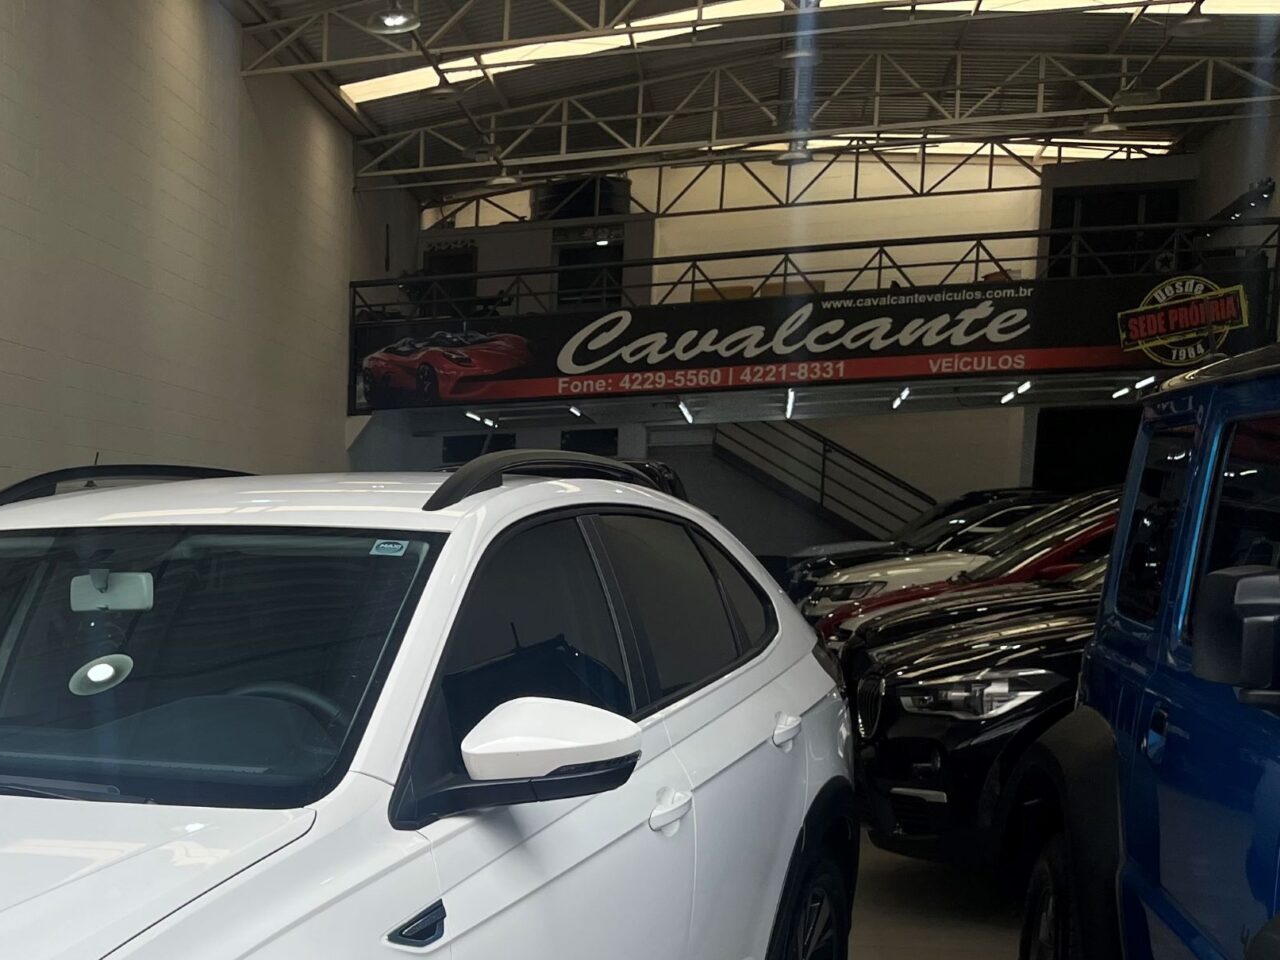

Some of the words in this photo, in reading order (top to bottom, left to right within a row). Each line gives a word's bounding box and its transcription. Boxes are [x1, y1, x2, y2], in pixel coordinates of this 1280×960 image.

[821, 286, 1034, 310] www.cavalcanteveiculos.com.br
[1152, 279, 1205, 303] Desde
[556, 301, 1031, 375] Cavalcante
[1127, 311, 1167, 341] SEDE
[928, 354, 1026, 374] VEÍCULOS
[1171, 343, 1205, 361] 1984
[557, 377, 613, 394] Fone:
[619, 369, 721, 390] 4229-5560
[739, 361, 845, 383] 4221-8331
